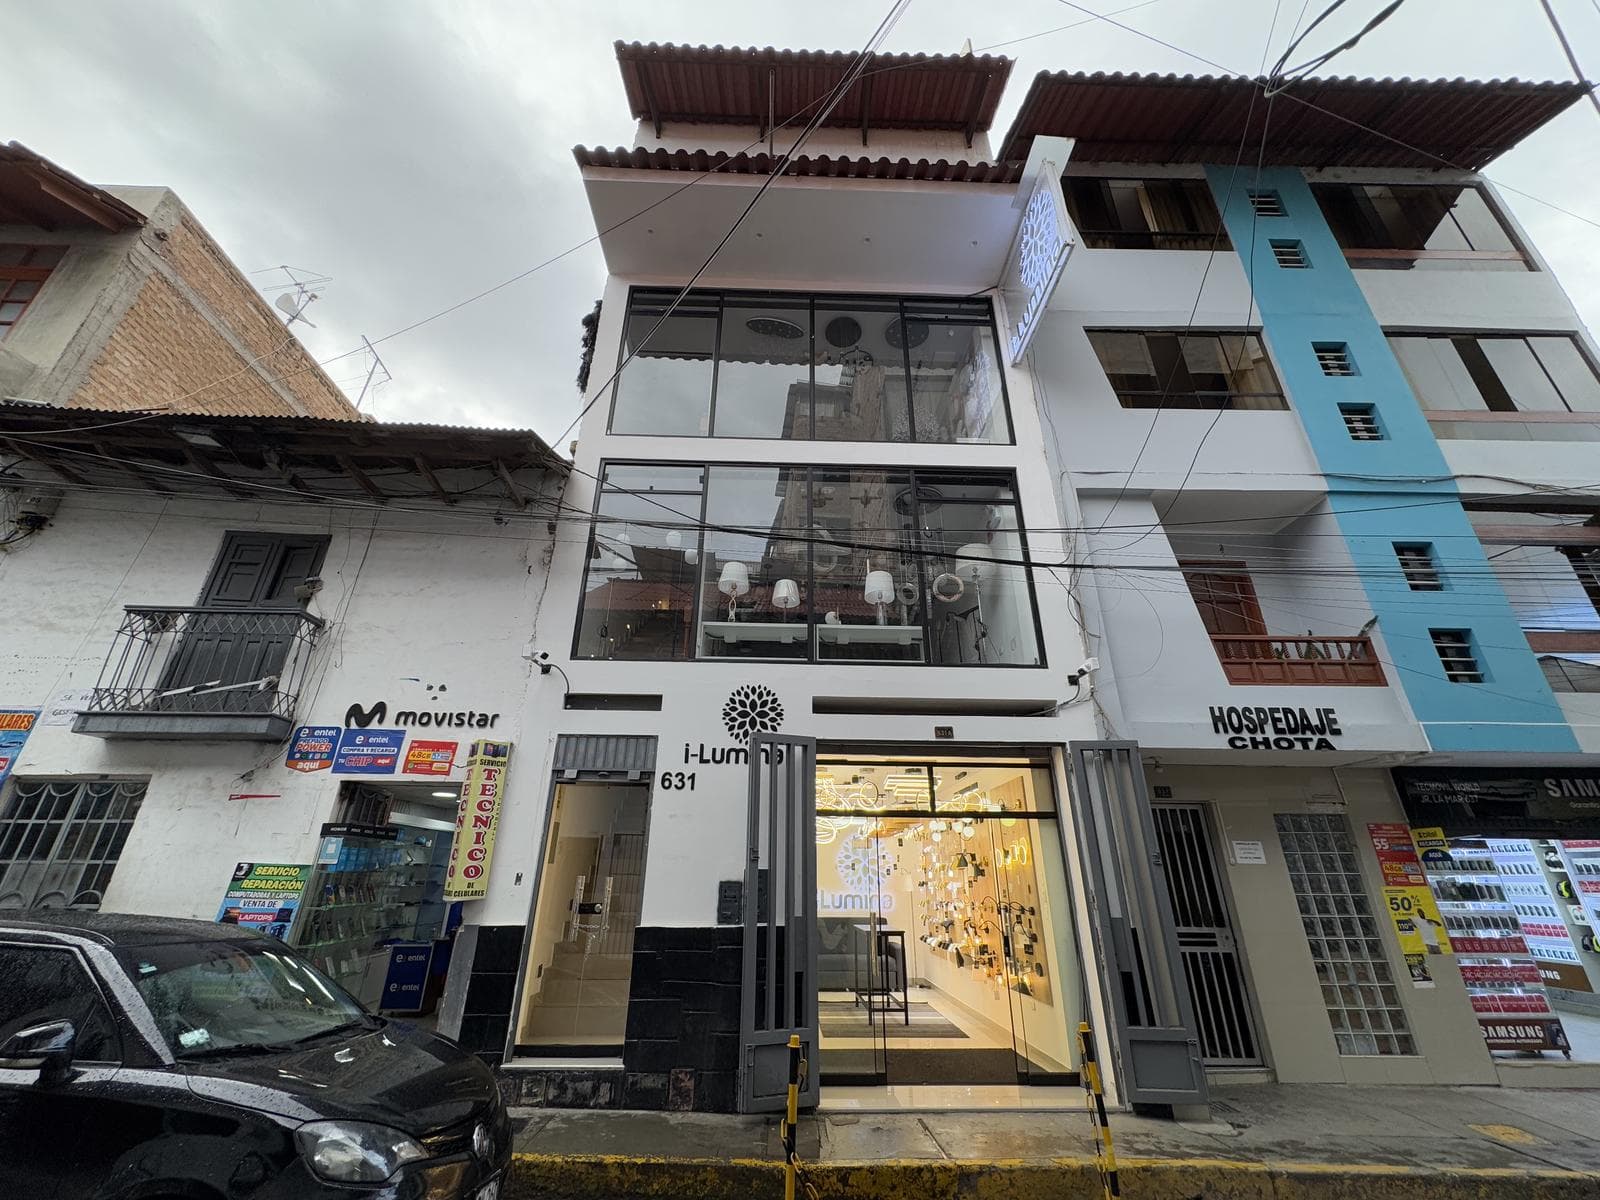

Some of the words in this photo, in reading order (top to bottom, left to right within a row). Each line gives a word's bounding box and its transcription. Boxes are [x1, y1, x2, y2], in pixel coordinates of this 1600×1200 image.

[394, 711, 500, 728] movistar
[1208, 705, 1343, 736] HOSPEDAJE
[314, 728, 337, 737] entel
[368, 736, 390, 744] entel
[1227, 736, 1338, 750] CHOTA
[294, 742, 333, 752] POWER
[683, 743, 784, 765] i-Lumna
[345, 756, 374, 767] CHIP
[479, 758, 508, 767] SERVICIO
[661, 772, 697, 791] 631
[1453, 782, 1481, 792] WORLD
[1543, 778, 1600, 798] SAM
[463, 767, 502, 880] TECNICO
[254, 866, 301, 876] SERVICIO
[240, 877, 305, 891] REPARACIÓN
[453, 889, 486, 898] CELULARES
[242, 900, 266, 908] VENTA
[267, 900, 279, 908] DE
[238, 913, 274, 921] LAPTOPS
[1481, 1025, 1545, 1038] SAMSUNG
